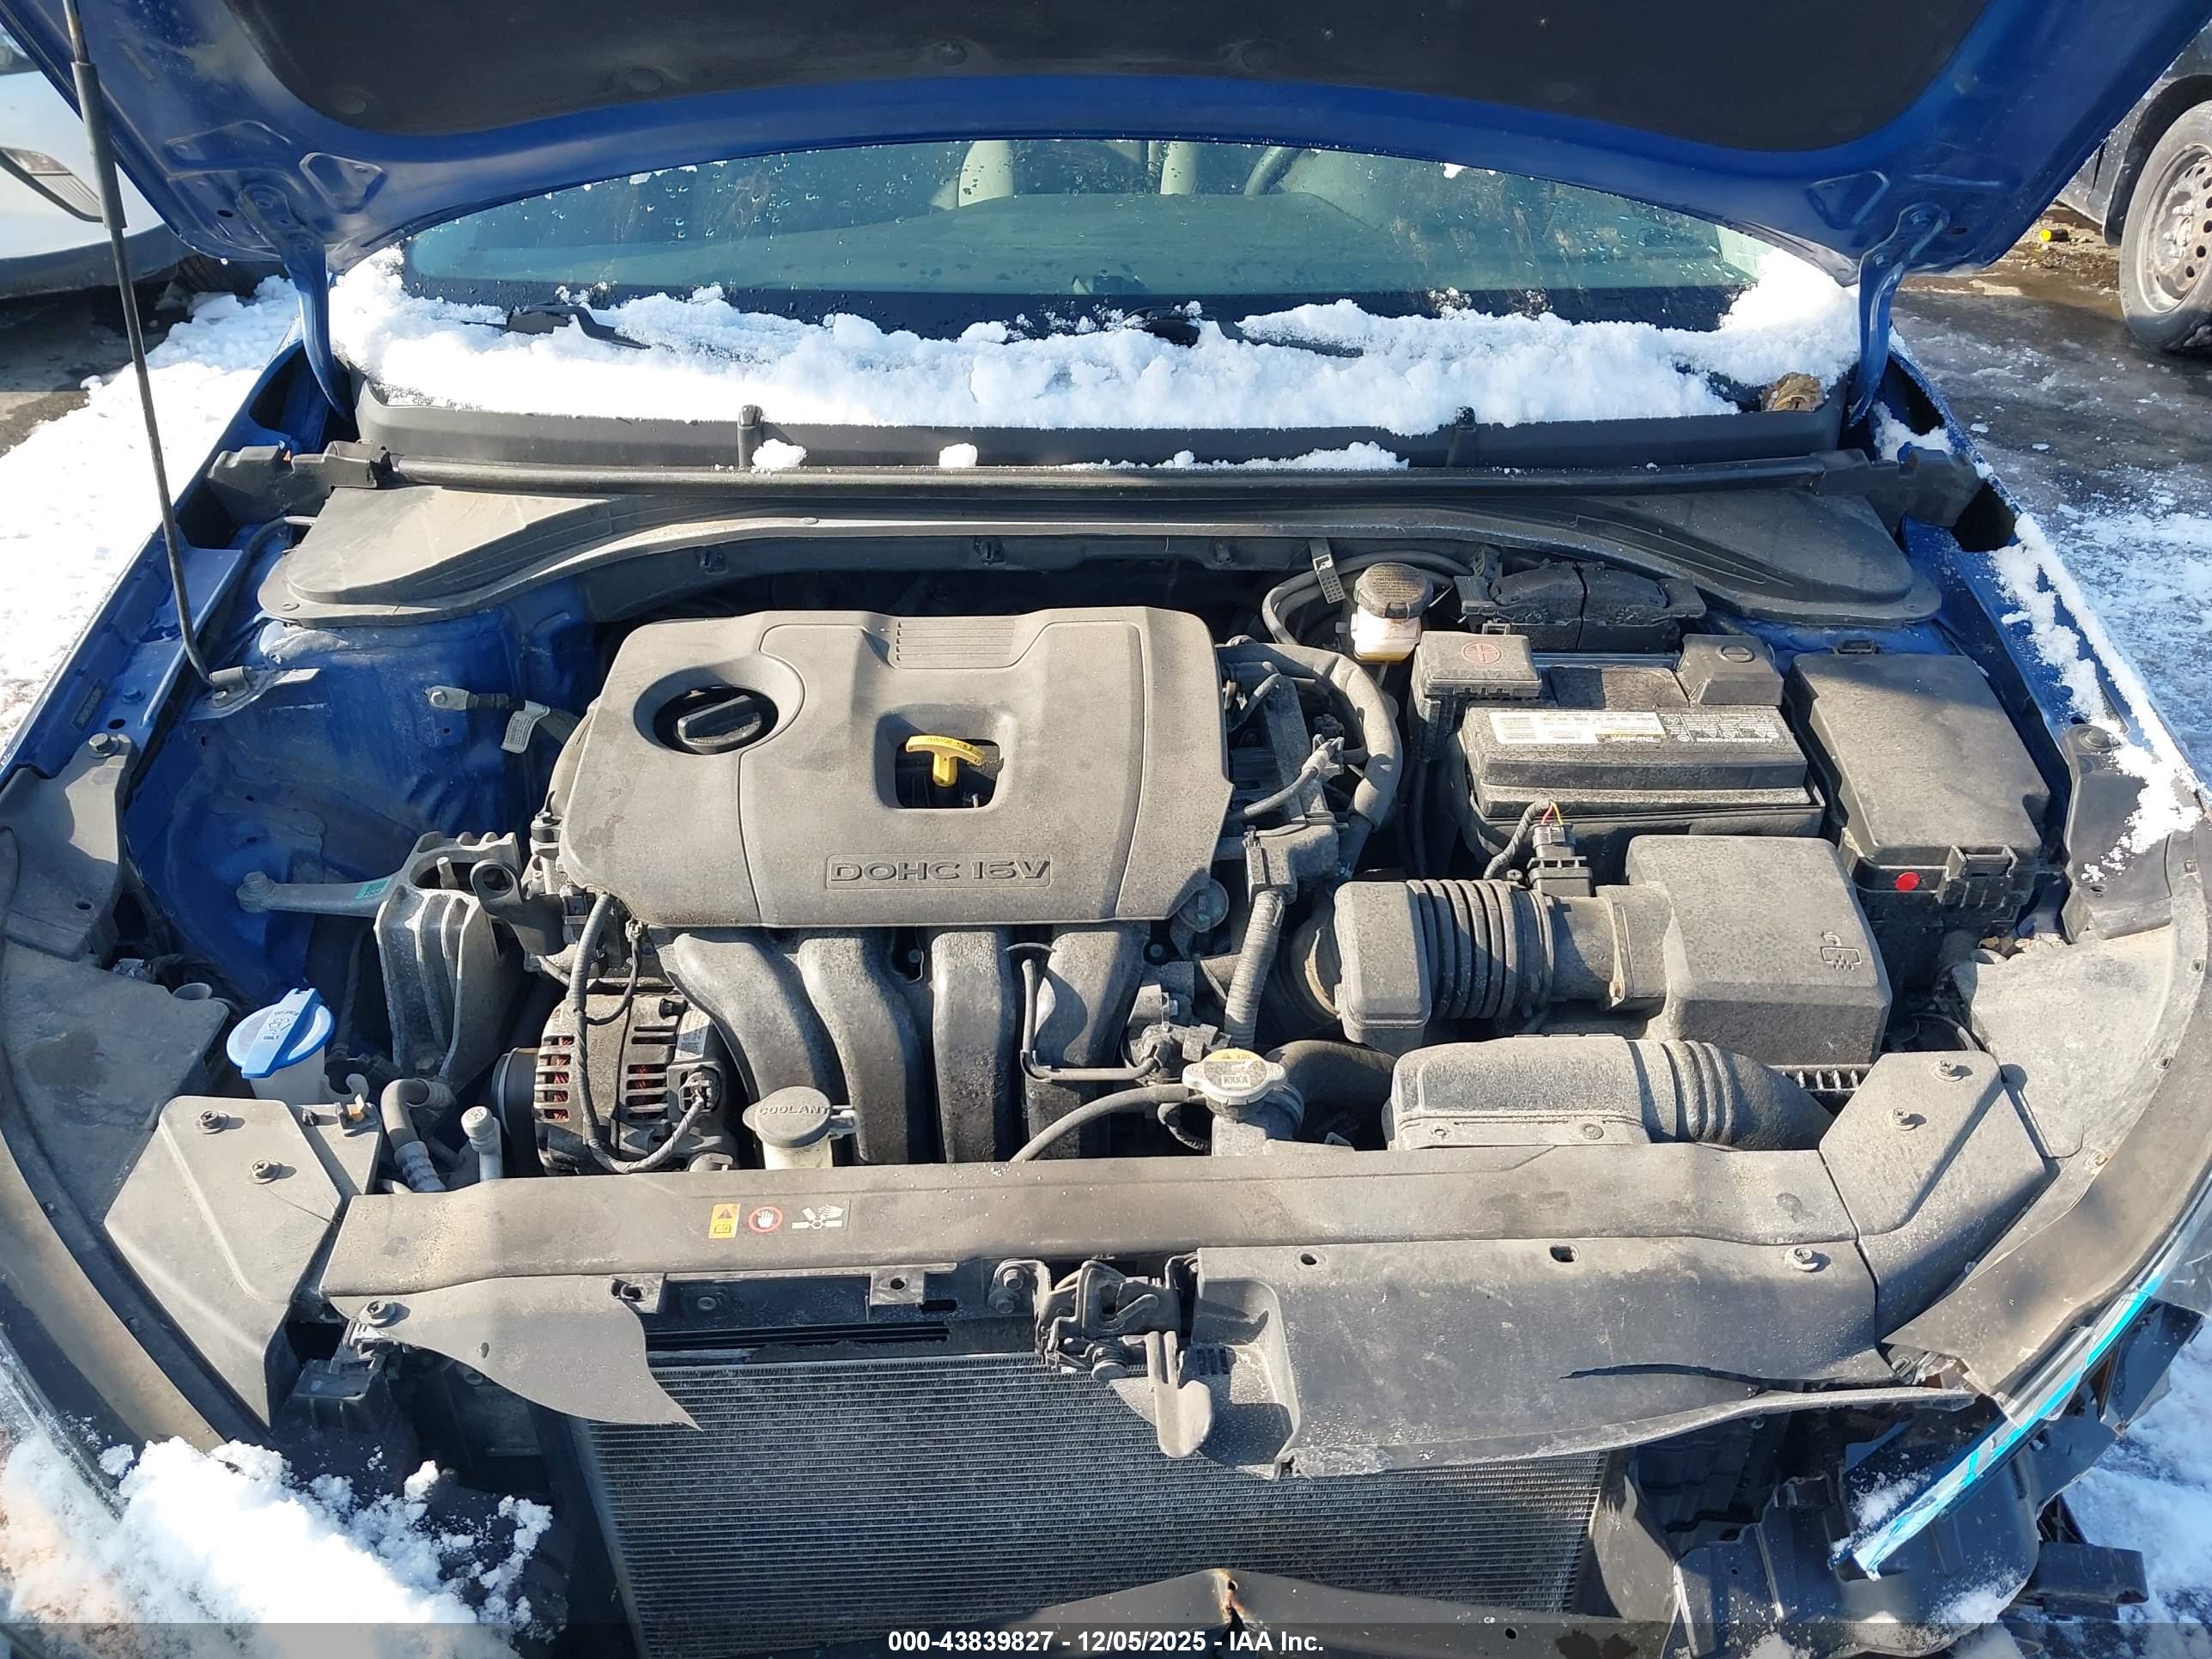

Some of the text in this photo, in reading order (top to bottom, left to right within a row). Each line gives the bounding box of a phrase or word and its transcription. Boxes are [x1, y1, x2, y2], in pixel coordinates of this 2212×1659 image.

[830, 860, 1050, 881] DOHC 16V
[759, 1104, 830, 1115] COOLANT
